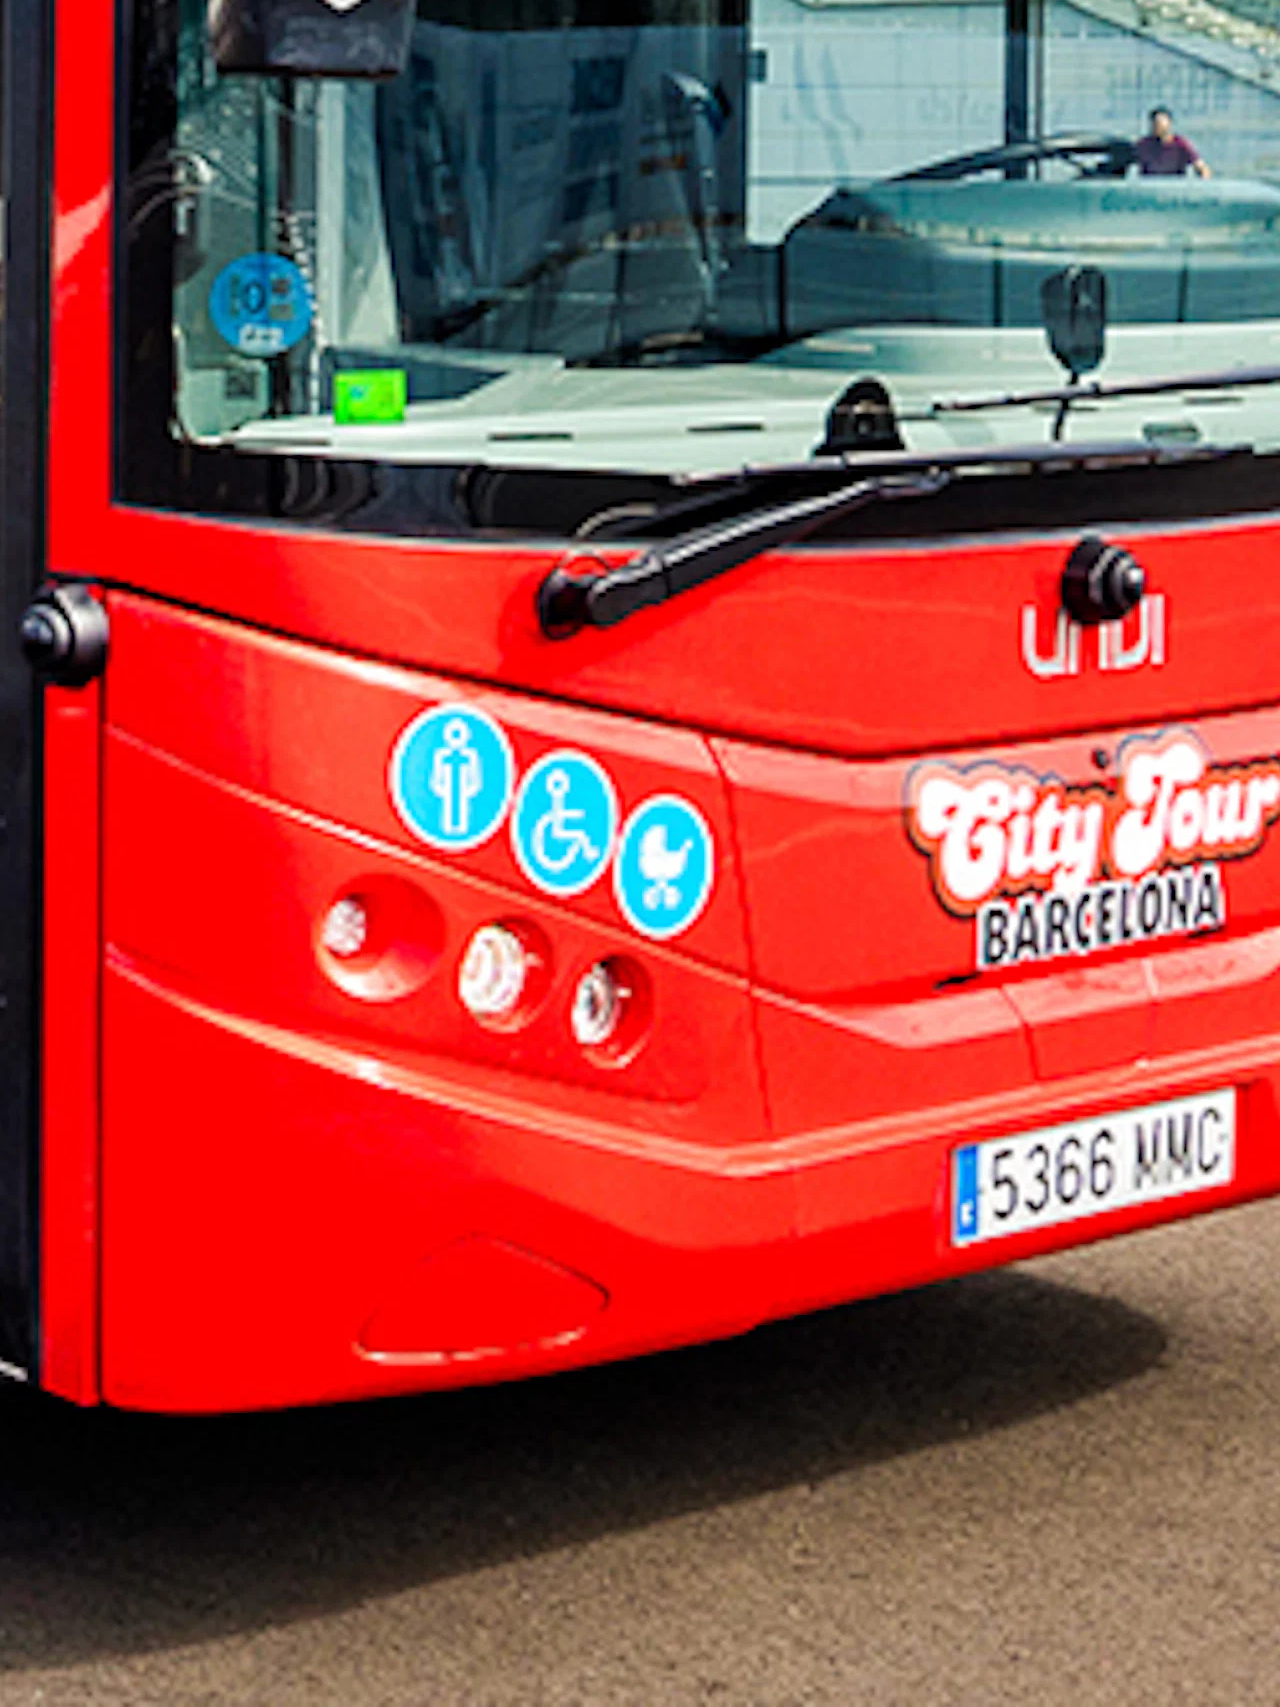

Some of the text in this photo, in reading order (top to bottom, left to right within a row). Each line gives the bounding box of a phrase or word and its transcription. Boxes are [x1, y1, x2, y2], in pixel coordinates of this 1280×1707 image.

[919, 741, 1280, 901] City Tour
[981, 871, 1222, 965] BARCELONA
[991, 1129, 1116, 1220] 5366
[1134, 1106, 1223, 1189] MMC
